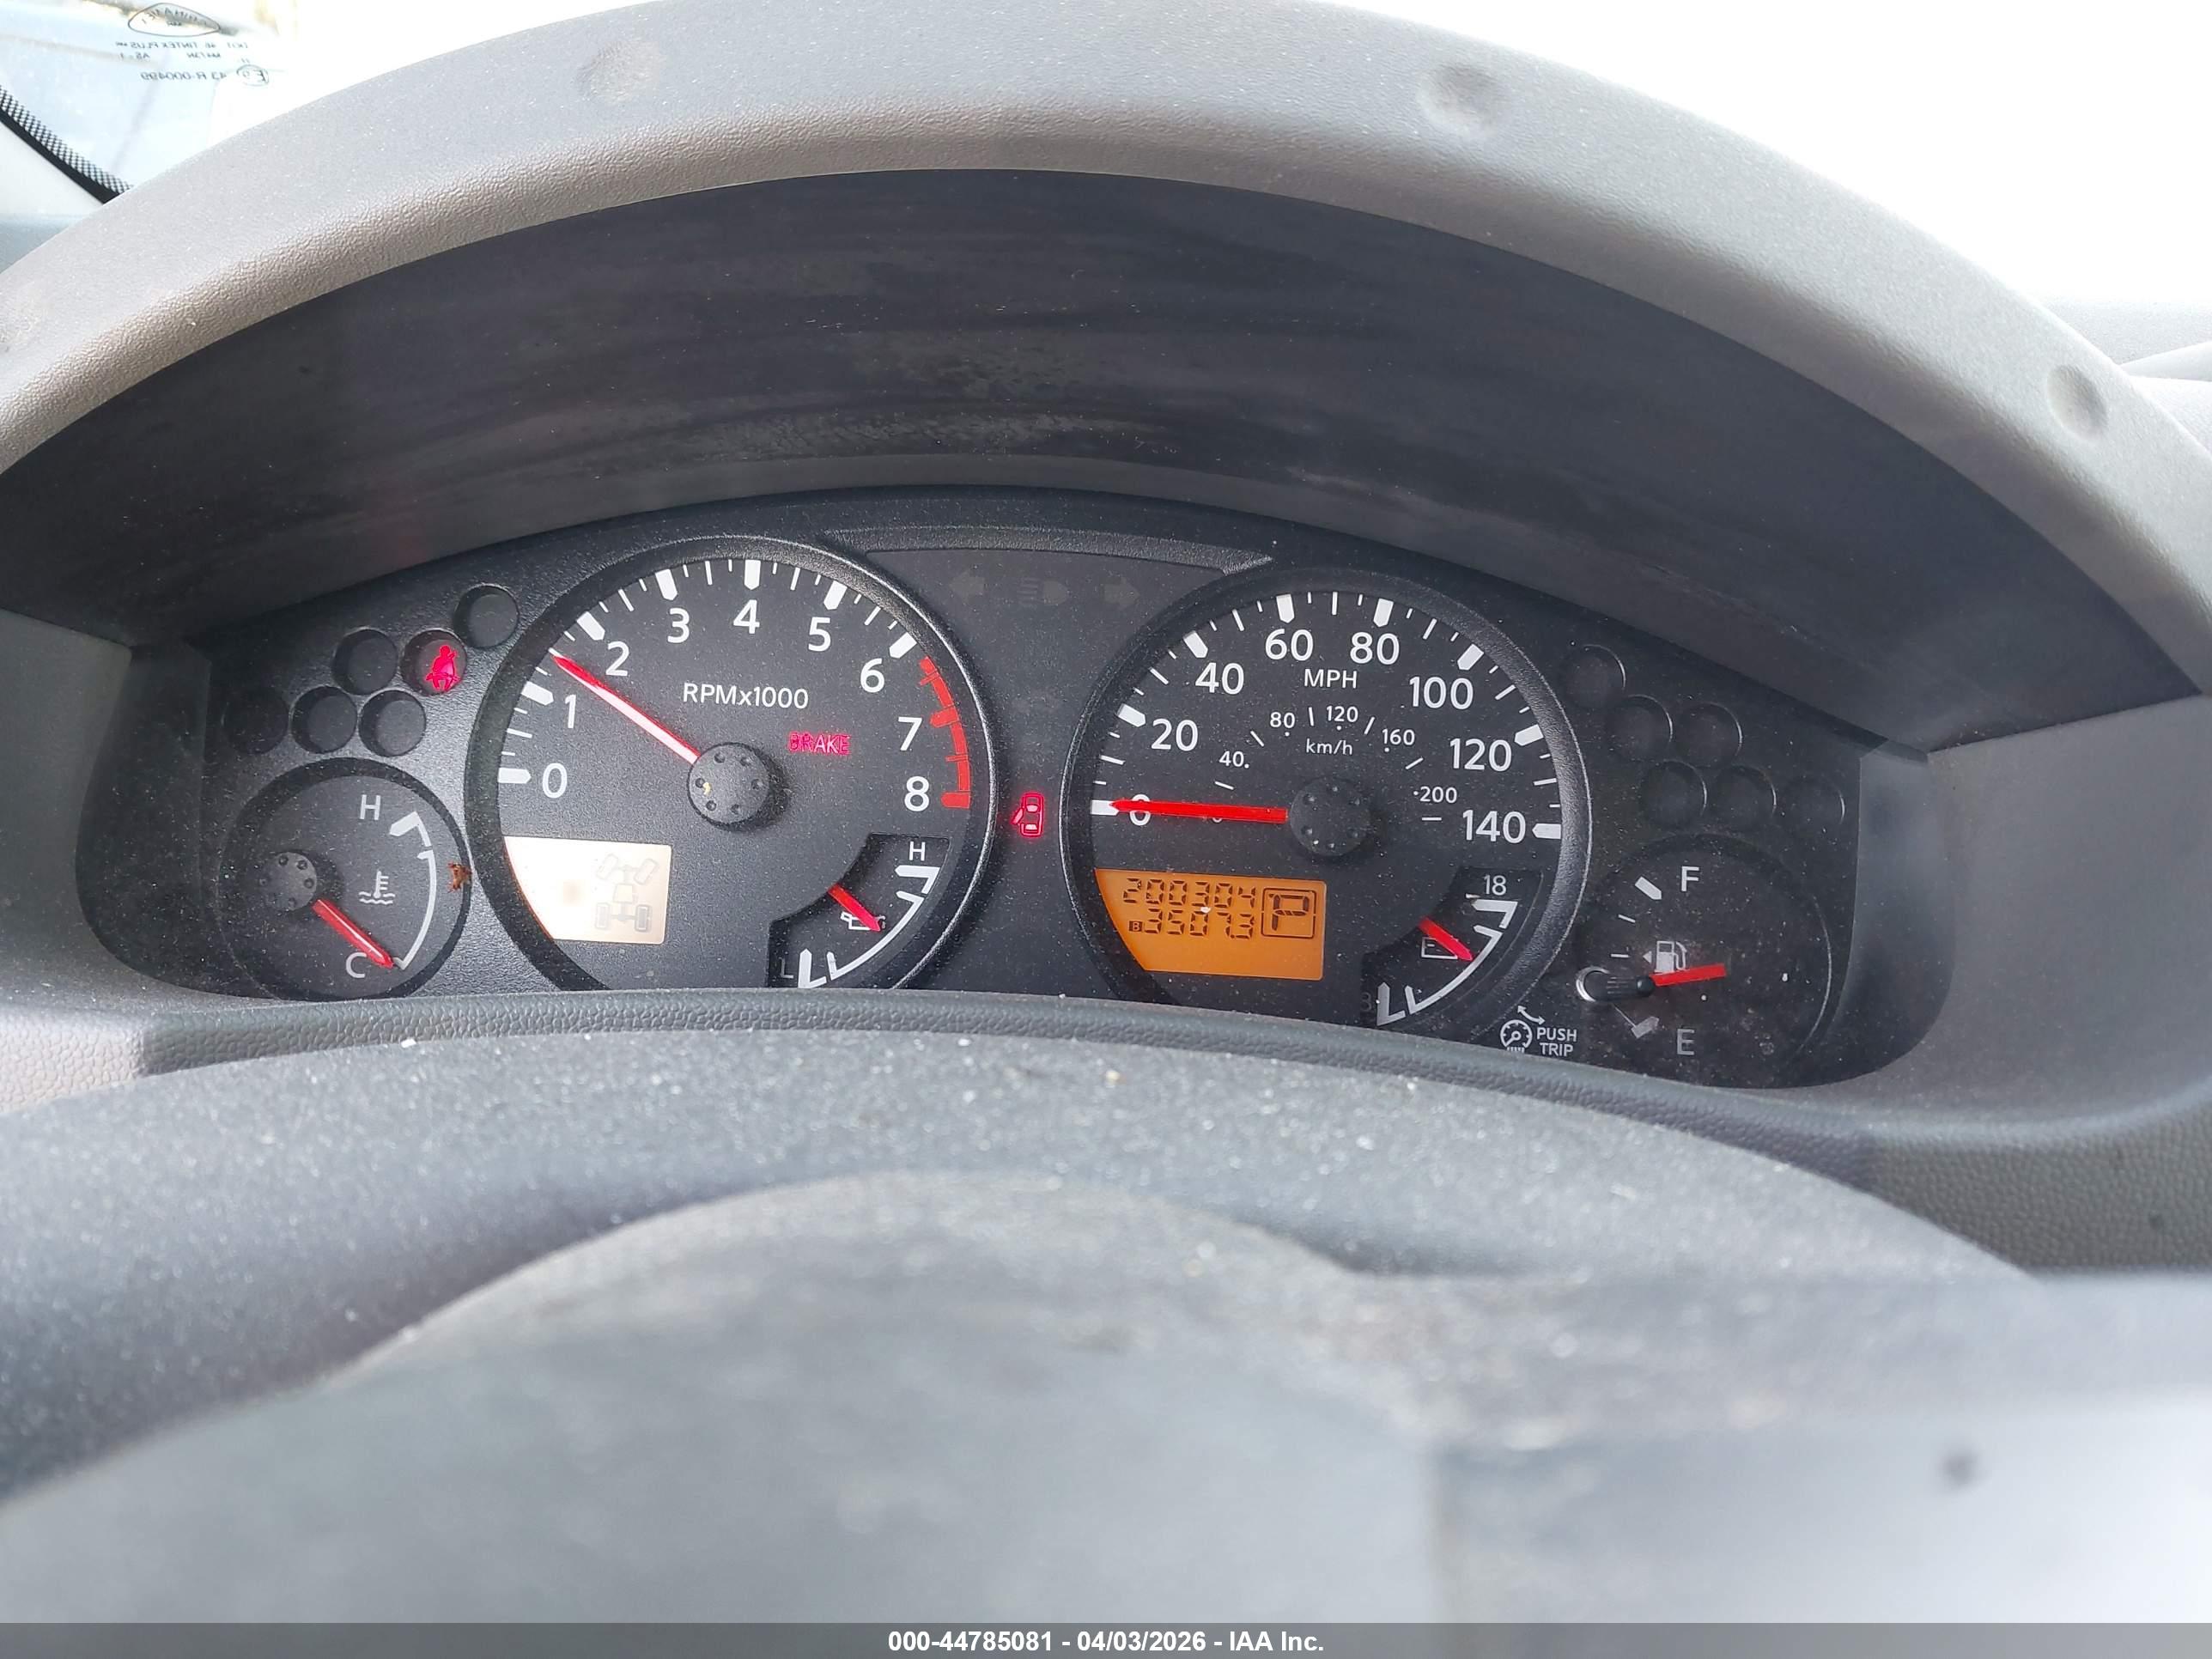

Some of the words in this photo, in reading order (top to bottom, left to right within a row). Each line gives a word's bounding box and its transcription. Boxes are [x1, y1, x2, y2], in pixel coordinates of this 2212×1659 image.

[667, 607, 690, 643] 3
[732, 599, 760, 635] 4
[808, 617, 831, 652] 5
[1265, 628, 1314, 661] 60
[1350, 631, 1400, 665] 80
[605, 641, 629, 677] 2
[860, 658, 885, 693] 6
[1194, 662, 1244, 695] 40
[1304, 668, 1358, 689] MPH
[683, 682, 809, 709] RPMx1000
[1409, 676, 1474, 710] 100
[564, 694, 577, 729] 1
[1269, 711, 1296, 729] 80
[1326, 705, 1358, 723] 120
[787, 731, 850, 757] BRAKE
[897, 716, 922, 751] 7
[1151, 718, 1199, 751] 20
[1306, 738, 1352, 755] km/h
[1382, 728, 1415, 745] 160
[1218, 750, 1244, 767] 40
[1449, 738, 1512, 772] 120
[542, 763, 568, 799] 0
[904, 775, 930, 812] 8
[1419, 786, 1457, 804] 200
[359, 794, 381, 821] H
[1462, 809, 1526, 844] 140
[908, 841, 926, 861] H
[1122, 878, 1256, 908] 200304
[1484, 875, 1507, 896] 18
[1681, 866, 1699, 892] F
[345, 951, 368, 979] C
[1536, 1027, 1577, 1042] PUSH
[1676, 1028, 1695, 1055] E
[1539, 1042, 1573, 1057] TRIP
